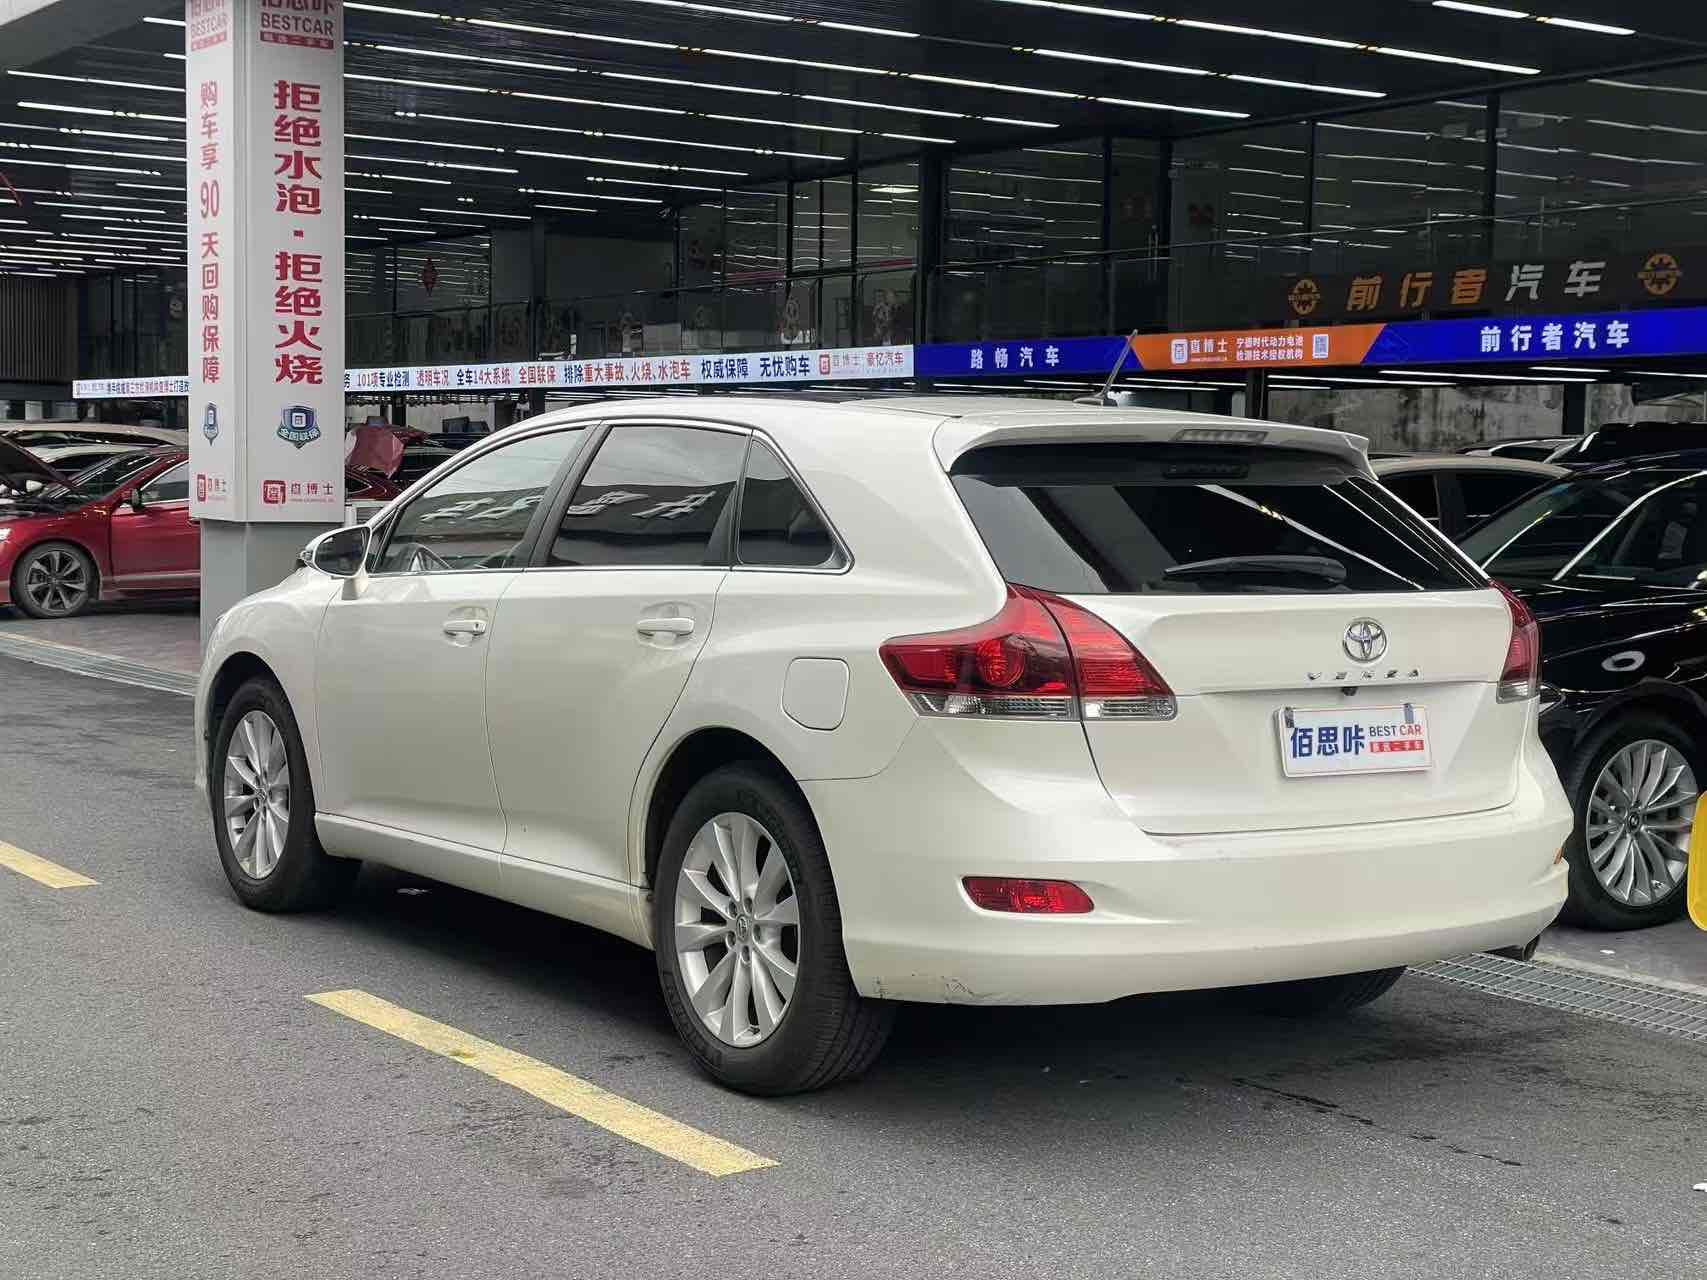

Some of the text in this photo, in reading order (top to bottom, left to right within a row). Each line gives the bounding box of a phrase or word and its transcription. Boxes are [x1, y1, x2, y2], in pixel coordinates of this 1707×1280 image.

[260, 12, 334, 37] BESTCAR
[1346, 261, 1606, 311] 前行者汽车
[1480, 320, 1630, 353] 前行者汽车
[357, 369, 410, 387] 101项专业检测
[415, 368, 449, 386] 透明车况
[456, 366, 512, 386] 全车14大系统
[518, 365, 557, 384] 全国联保
[701, 358, 749, 379] 权威保障
[759, 355, 810, 377] 无忧购车
[970, 345, 1060, 369] 路畅汽车
[1291, 724, 1365, 758] 佰思咔
[1369, 723, 1423, 737] BEST CAR
